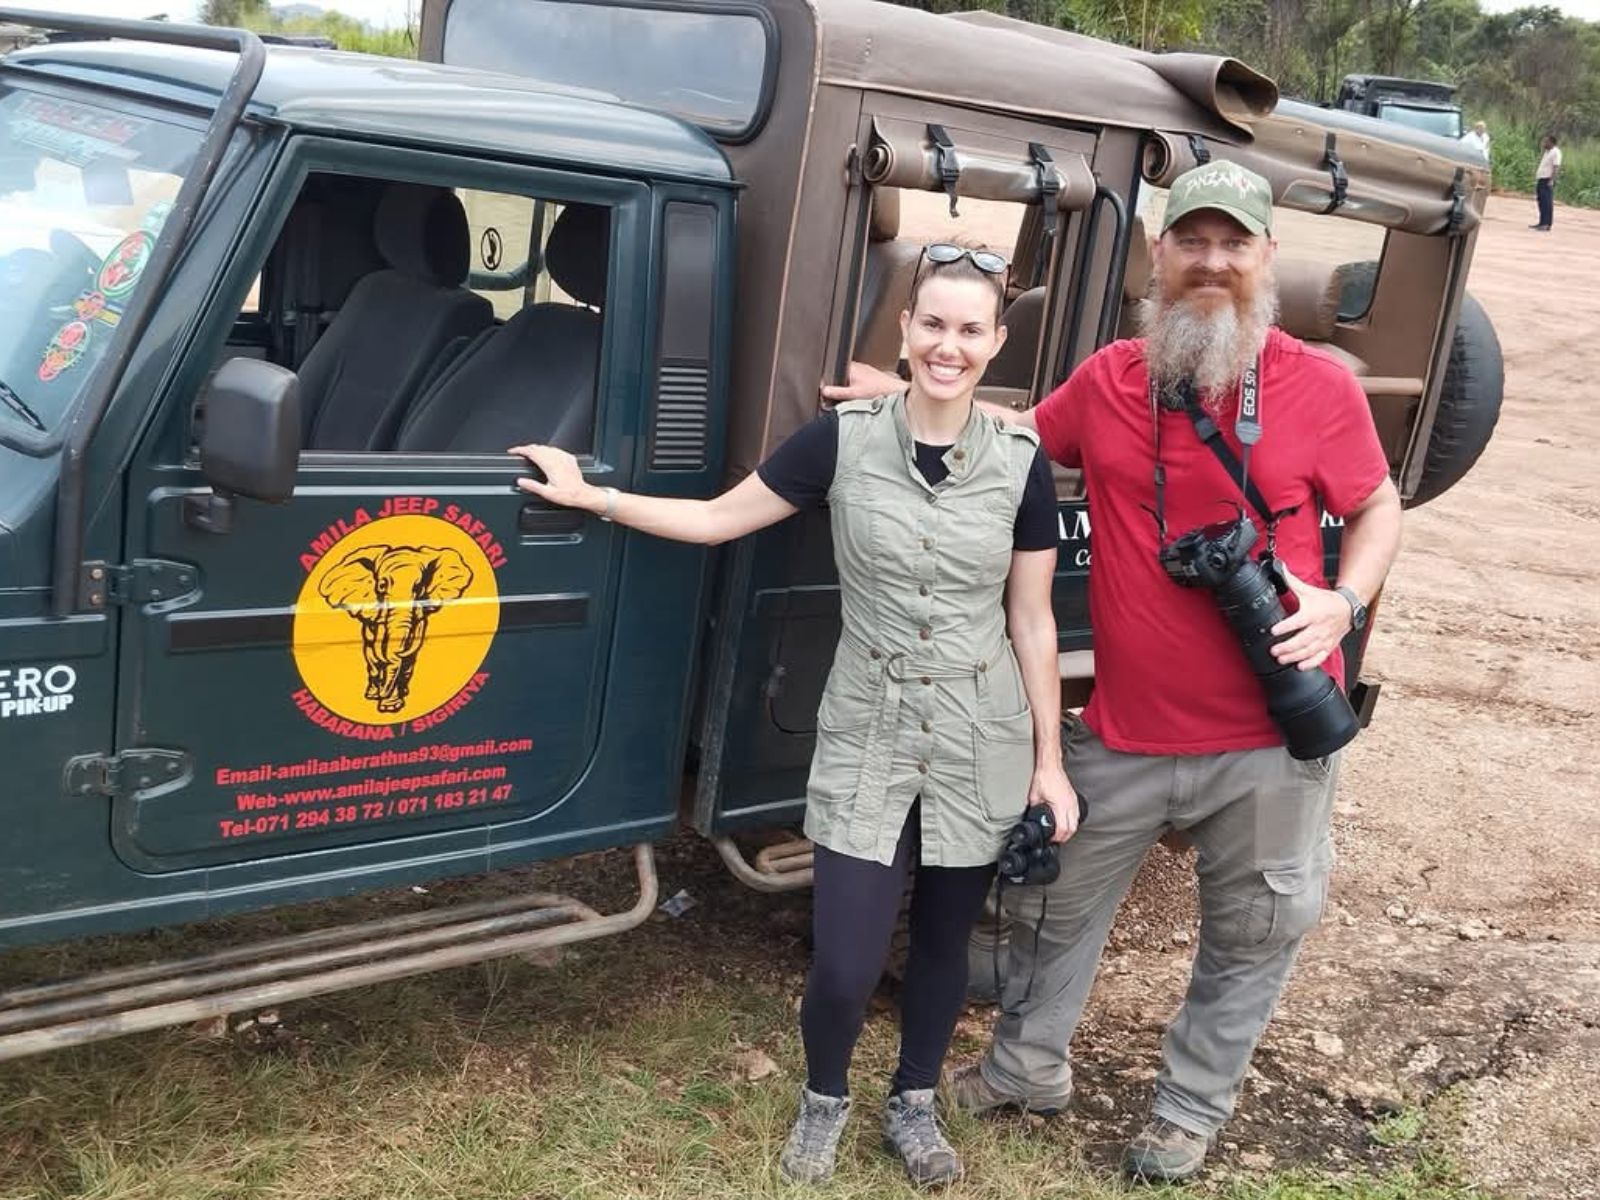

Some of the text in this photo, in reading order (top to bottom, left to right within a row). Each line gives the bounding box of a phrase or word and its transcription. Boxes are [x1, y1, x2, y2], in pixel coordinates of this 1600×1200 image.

[1243, 388, 1256, 416] EOS
[300, 497, 508, 571] AMILA JEEP SAFARI
[291, 687, 395, 741] HABARANA
[411, 672, 490, 733] SIGIRIYA
[220, 783, 513, 838] Tel-071 294 38 72 / 071 183 21 47
[236, 766, 507, 811] Web-www.amilajeepsafari.com
